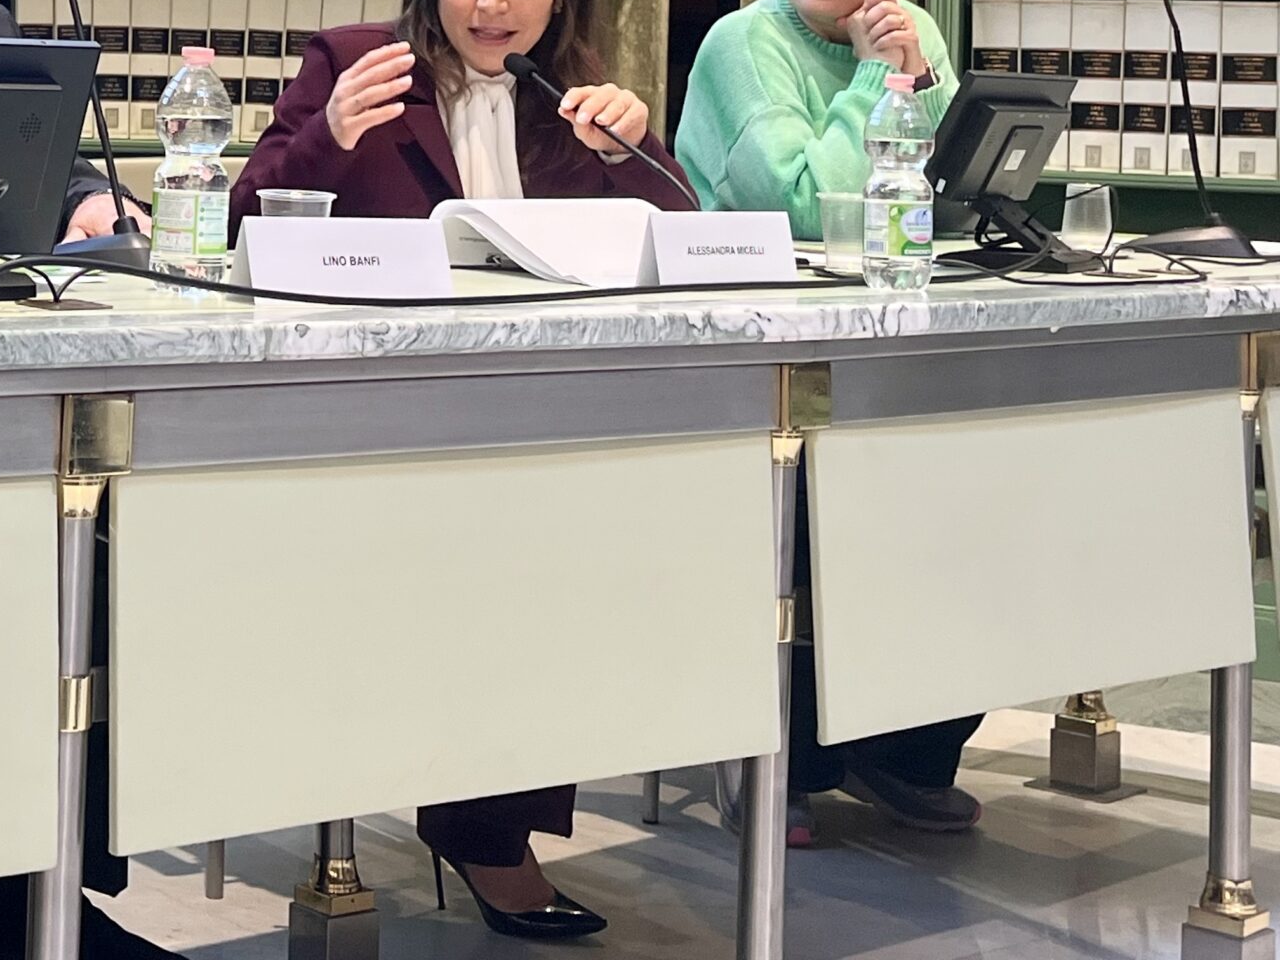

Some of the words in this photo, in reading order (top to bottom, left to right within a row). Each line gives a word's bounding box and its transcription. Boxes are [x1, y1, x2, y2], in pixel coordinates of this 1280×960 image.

[687, 245, 736, 256] ALESSANDRA
[322, 255, 347, 266] LINO
[348, 255, 380, 266] BANFI
